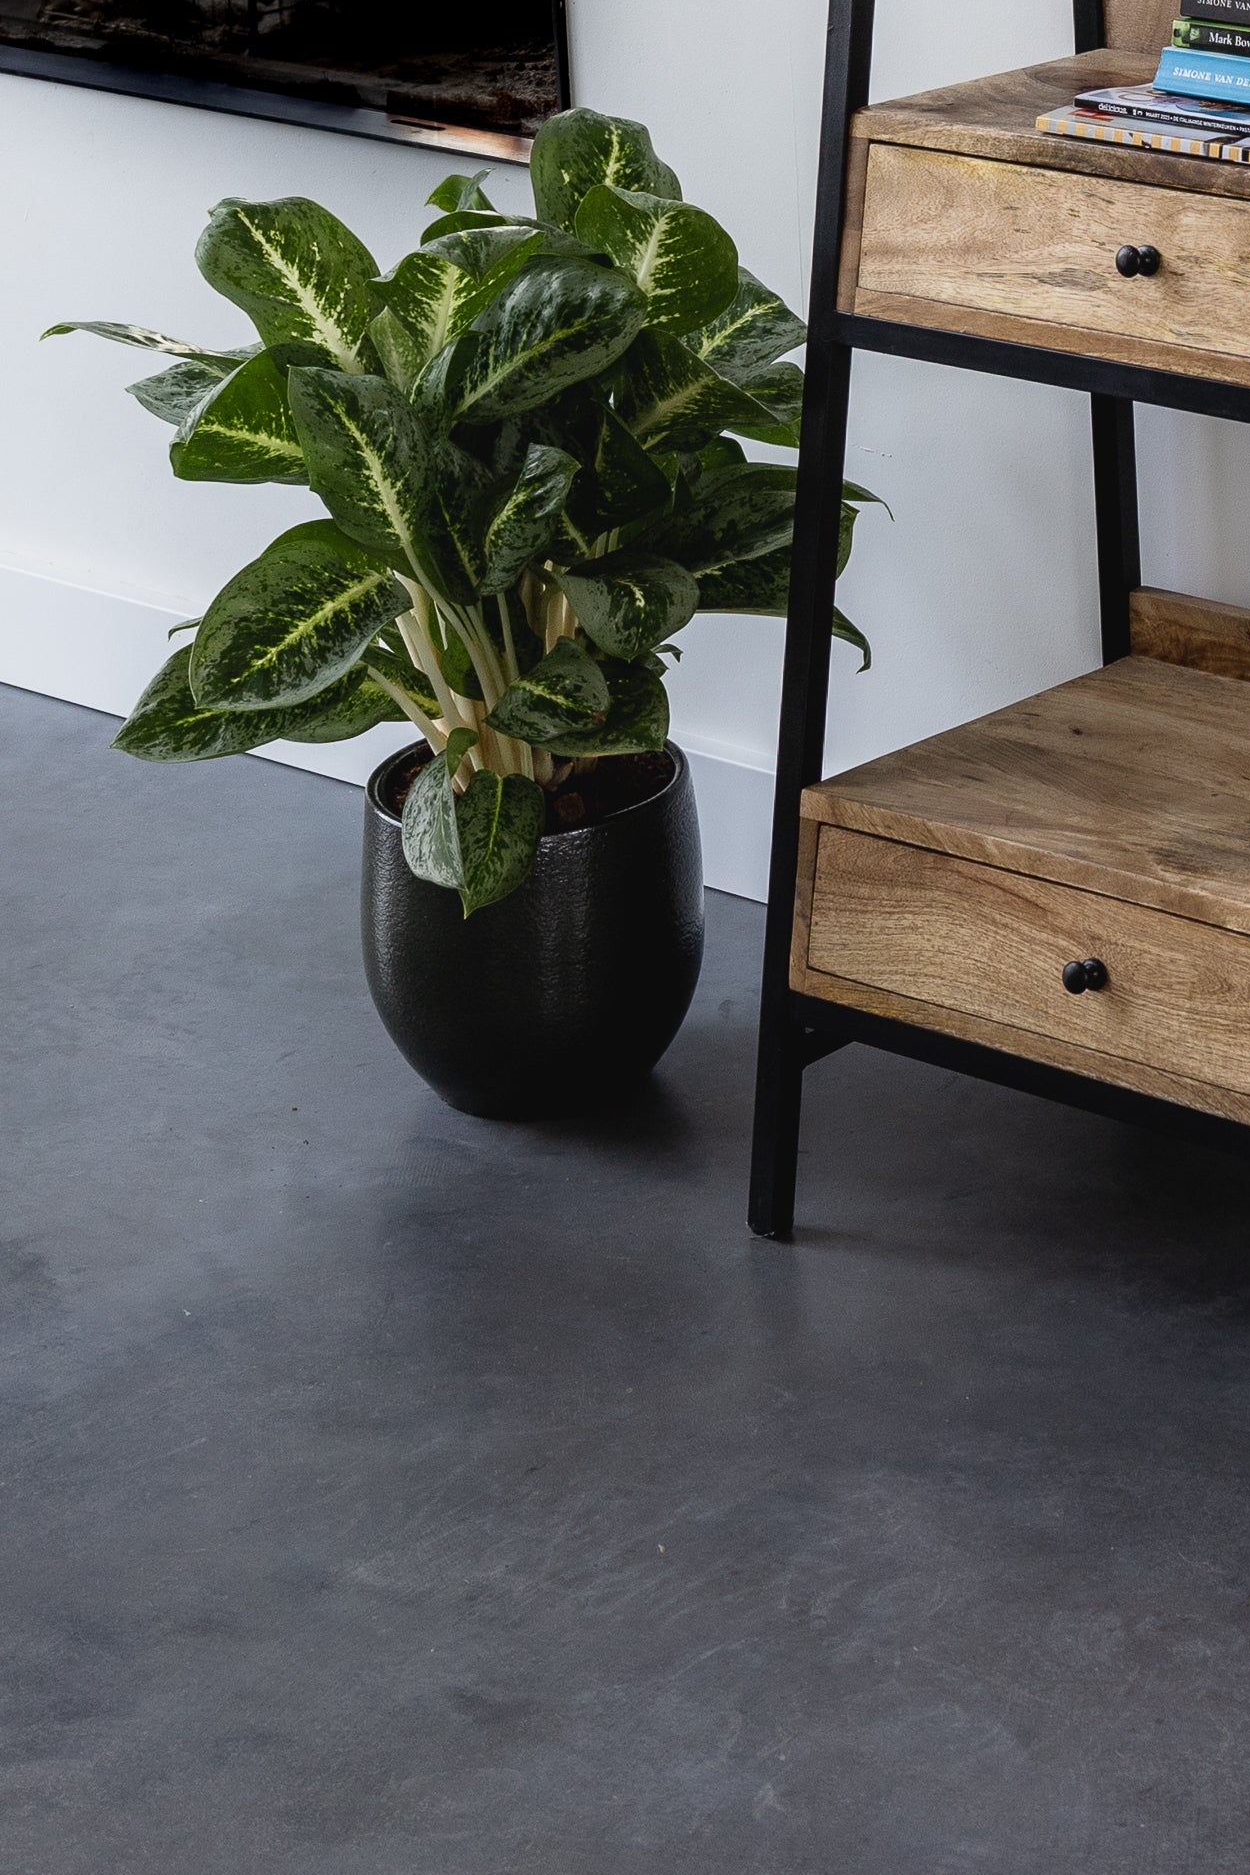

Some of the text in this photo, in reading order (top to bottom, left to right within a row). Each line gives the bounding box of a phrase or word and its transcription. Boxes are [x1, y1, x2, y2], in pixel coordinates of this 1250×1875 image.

[1209, 32, 1233, 45] Mark
[1173, 67, 1211, 81] SIMONE
[1215, 74, 1234, 84] VAN
